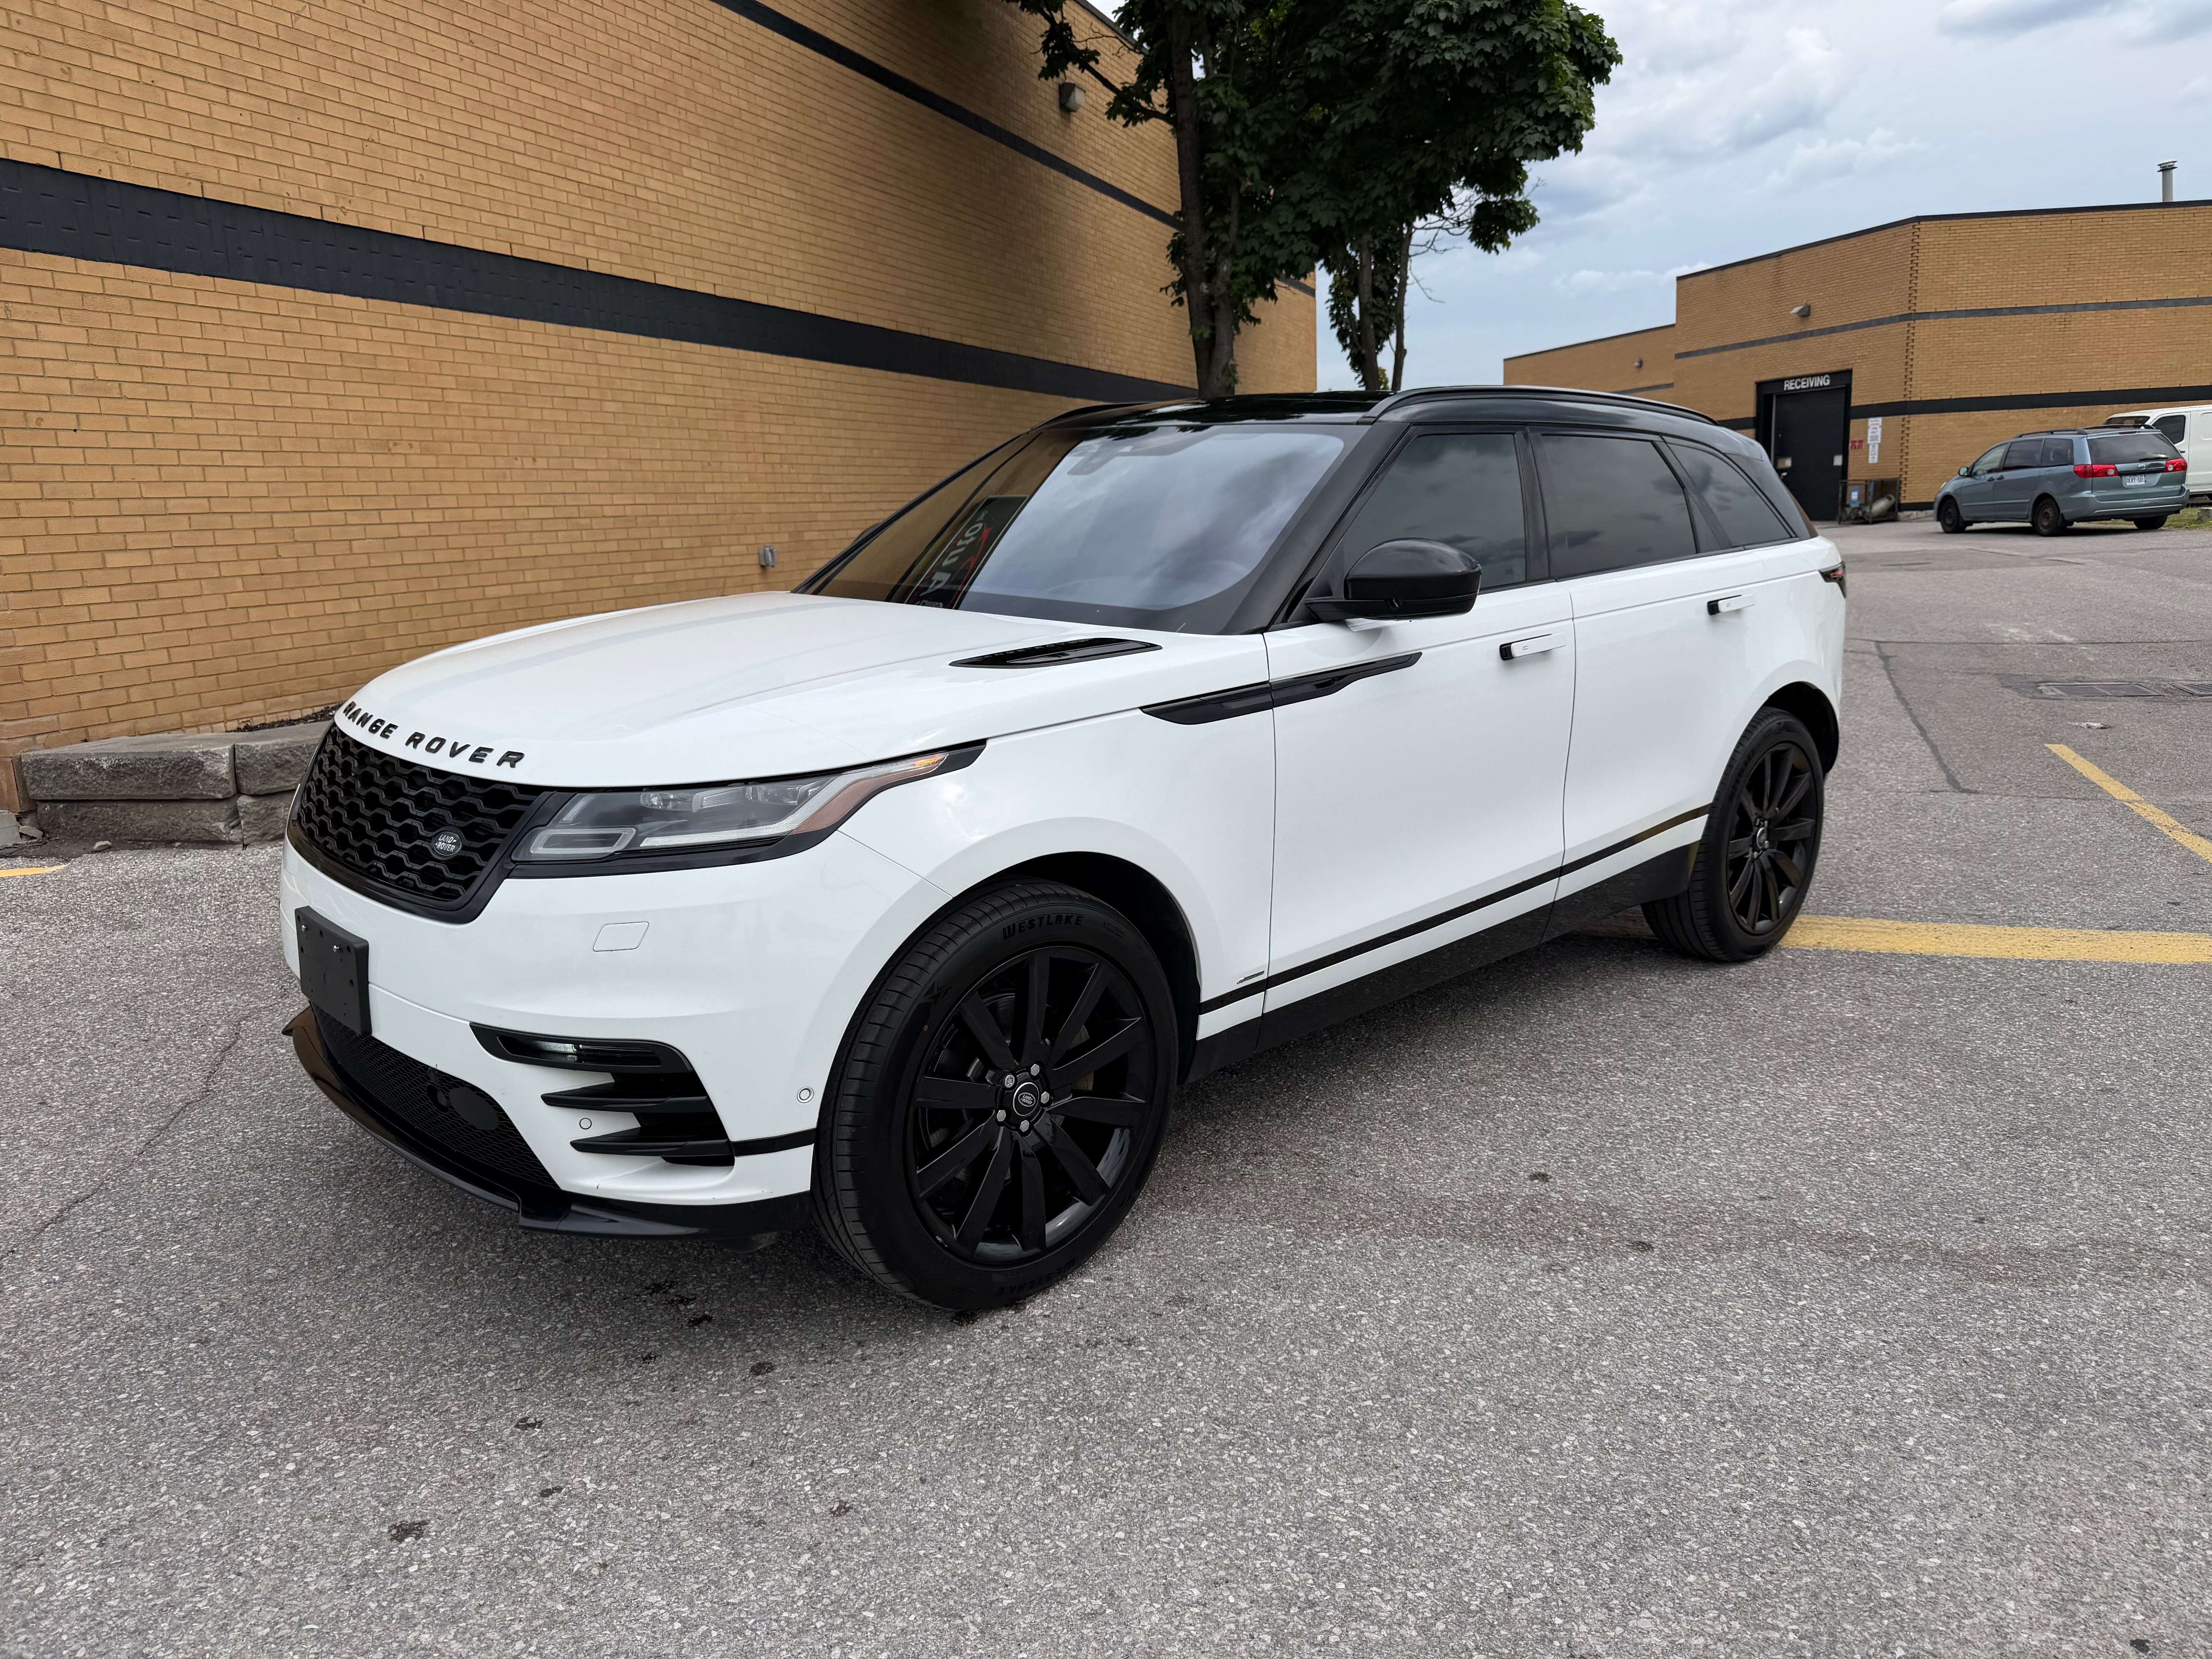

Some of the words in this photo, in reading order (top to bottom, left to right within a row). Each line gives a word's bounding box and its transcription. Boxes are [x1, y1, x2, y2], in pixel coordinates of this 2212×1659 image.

[1784, 374, 1830, 391] RECEIVING
[343, 701, 398, 740] RANGE
[405, 732, 525, 768] ROVER
[437, 841, 455, 852] ROVER
[438, 834, 454, 843] LAND
[1002, 914, 1084, 941] WESTLAKE
